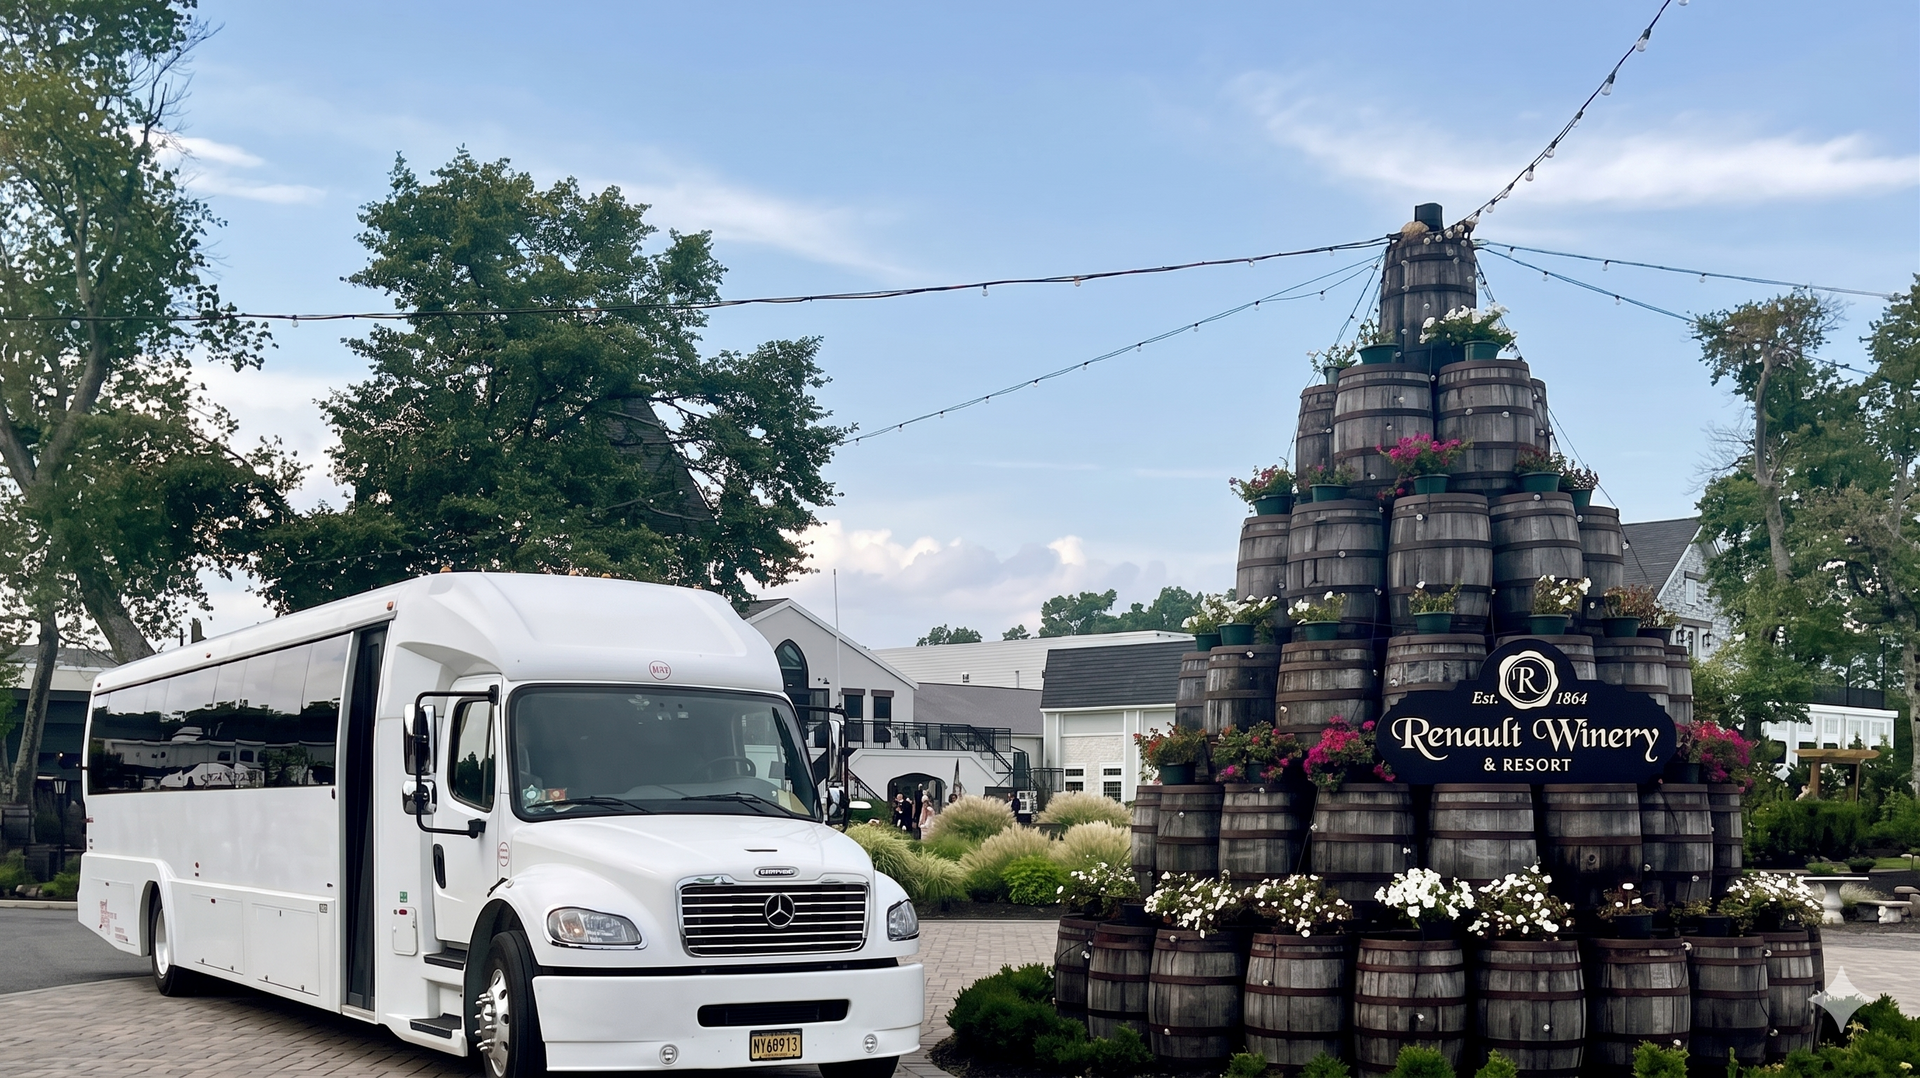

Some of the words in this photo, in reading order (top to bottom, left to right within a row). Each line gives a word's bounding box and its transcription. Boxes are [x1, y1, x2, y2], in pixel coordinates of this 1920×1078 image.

[1512, 666, 1548, 695] R
[1472, 691, 1499, 705] Est.
[1556, 692, 1588, 705] 1864
[1391, 717, 1522, 761] Renault
[1532, 718, 1660, 763] Winery
[1484, 757, 1497, 772] &
[1503, 758, 1572, 772] RESORT
